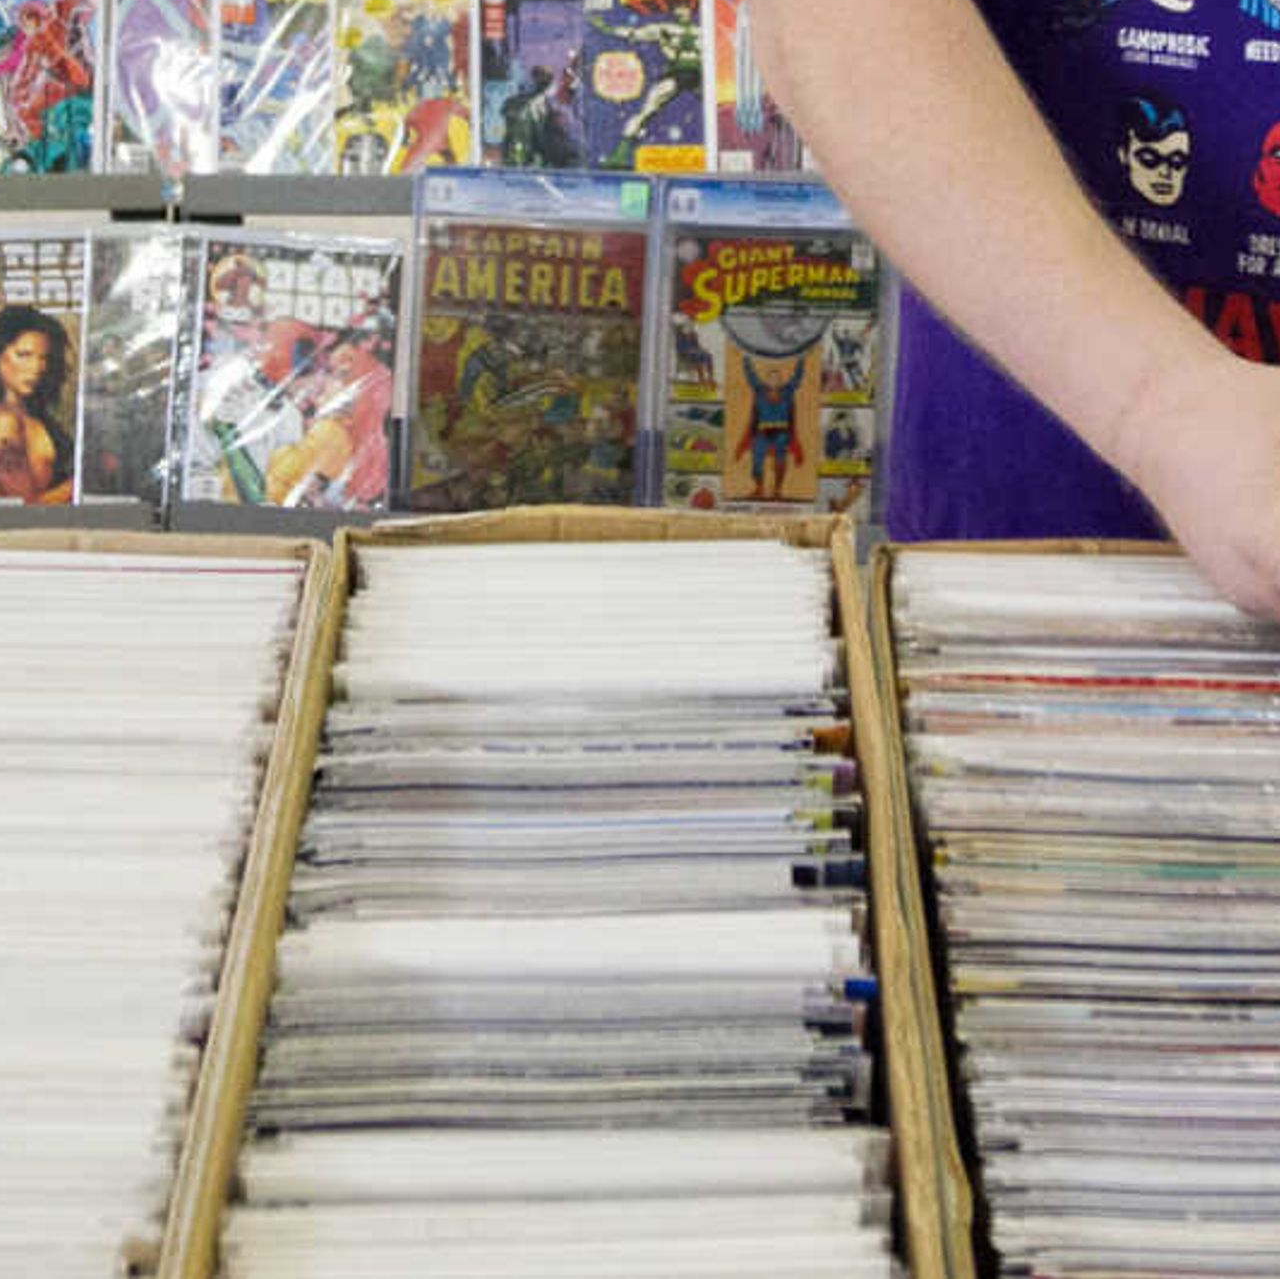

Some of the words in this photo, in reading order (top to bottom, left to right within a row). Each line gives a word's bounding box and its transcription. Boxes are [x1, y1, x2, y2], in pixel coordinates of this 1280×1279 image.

[464, 228, 605, 262] CAPTAIN
[718, 244, 797, 271] GIANT
[1237, 252, 1267, 276] FOR
[429, 257, 631, 311] AMERICA
[691, 257, 862, 323] SUPERMAN
